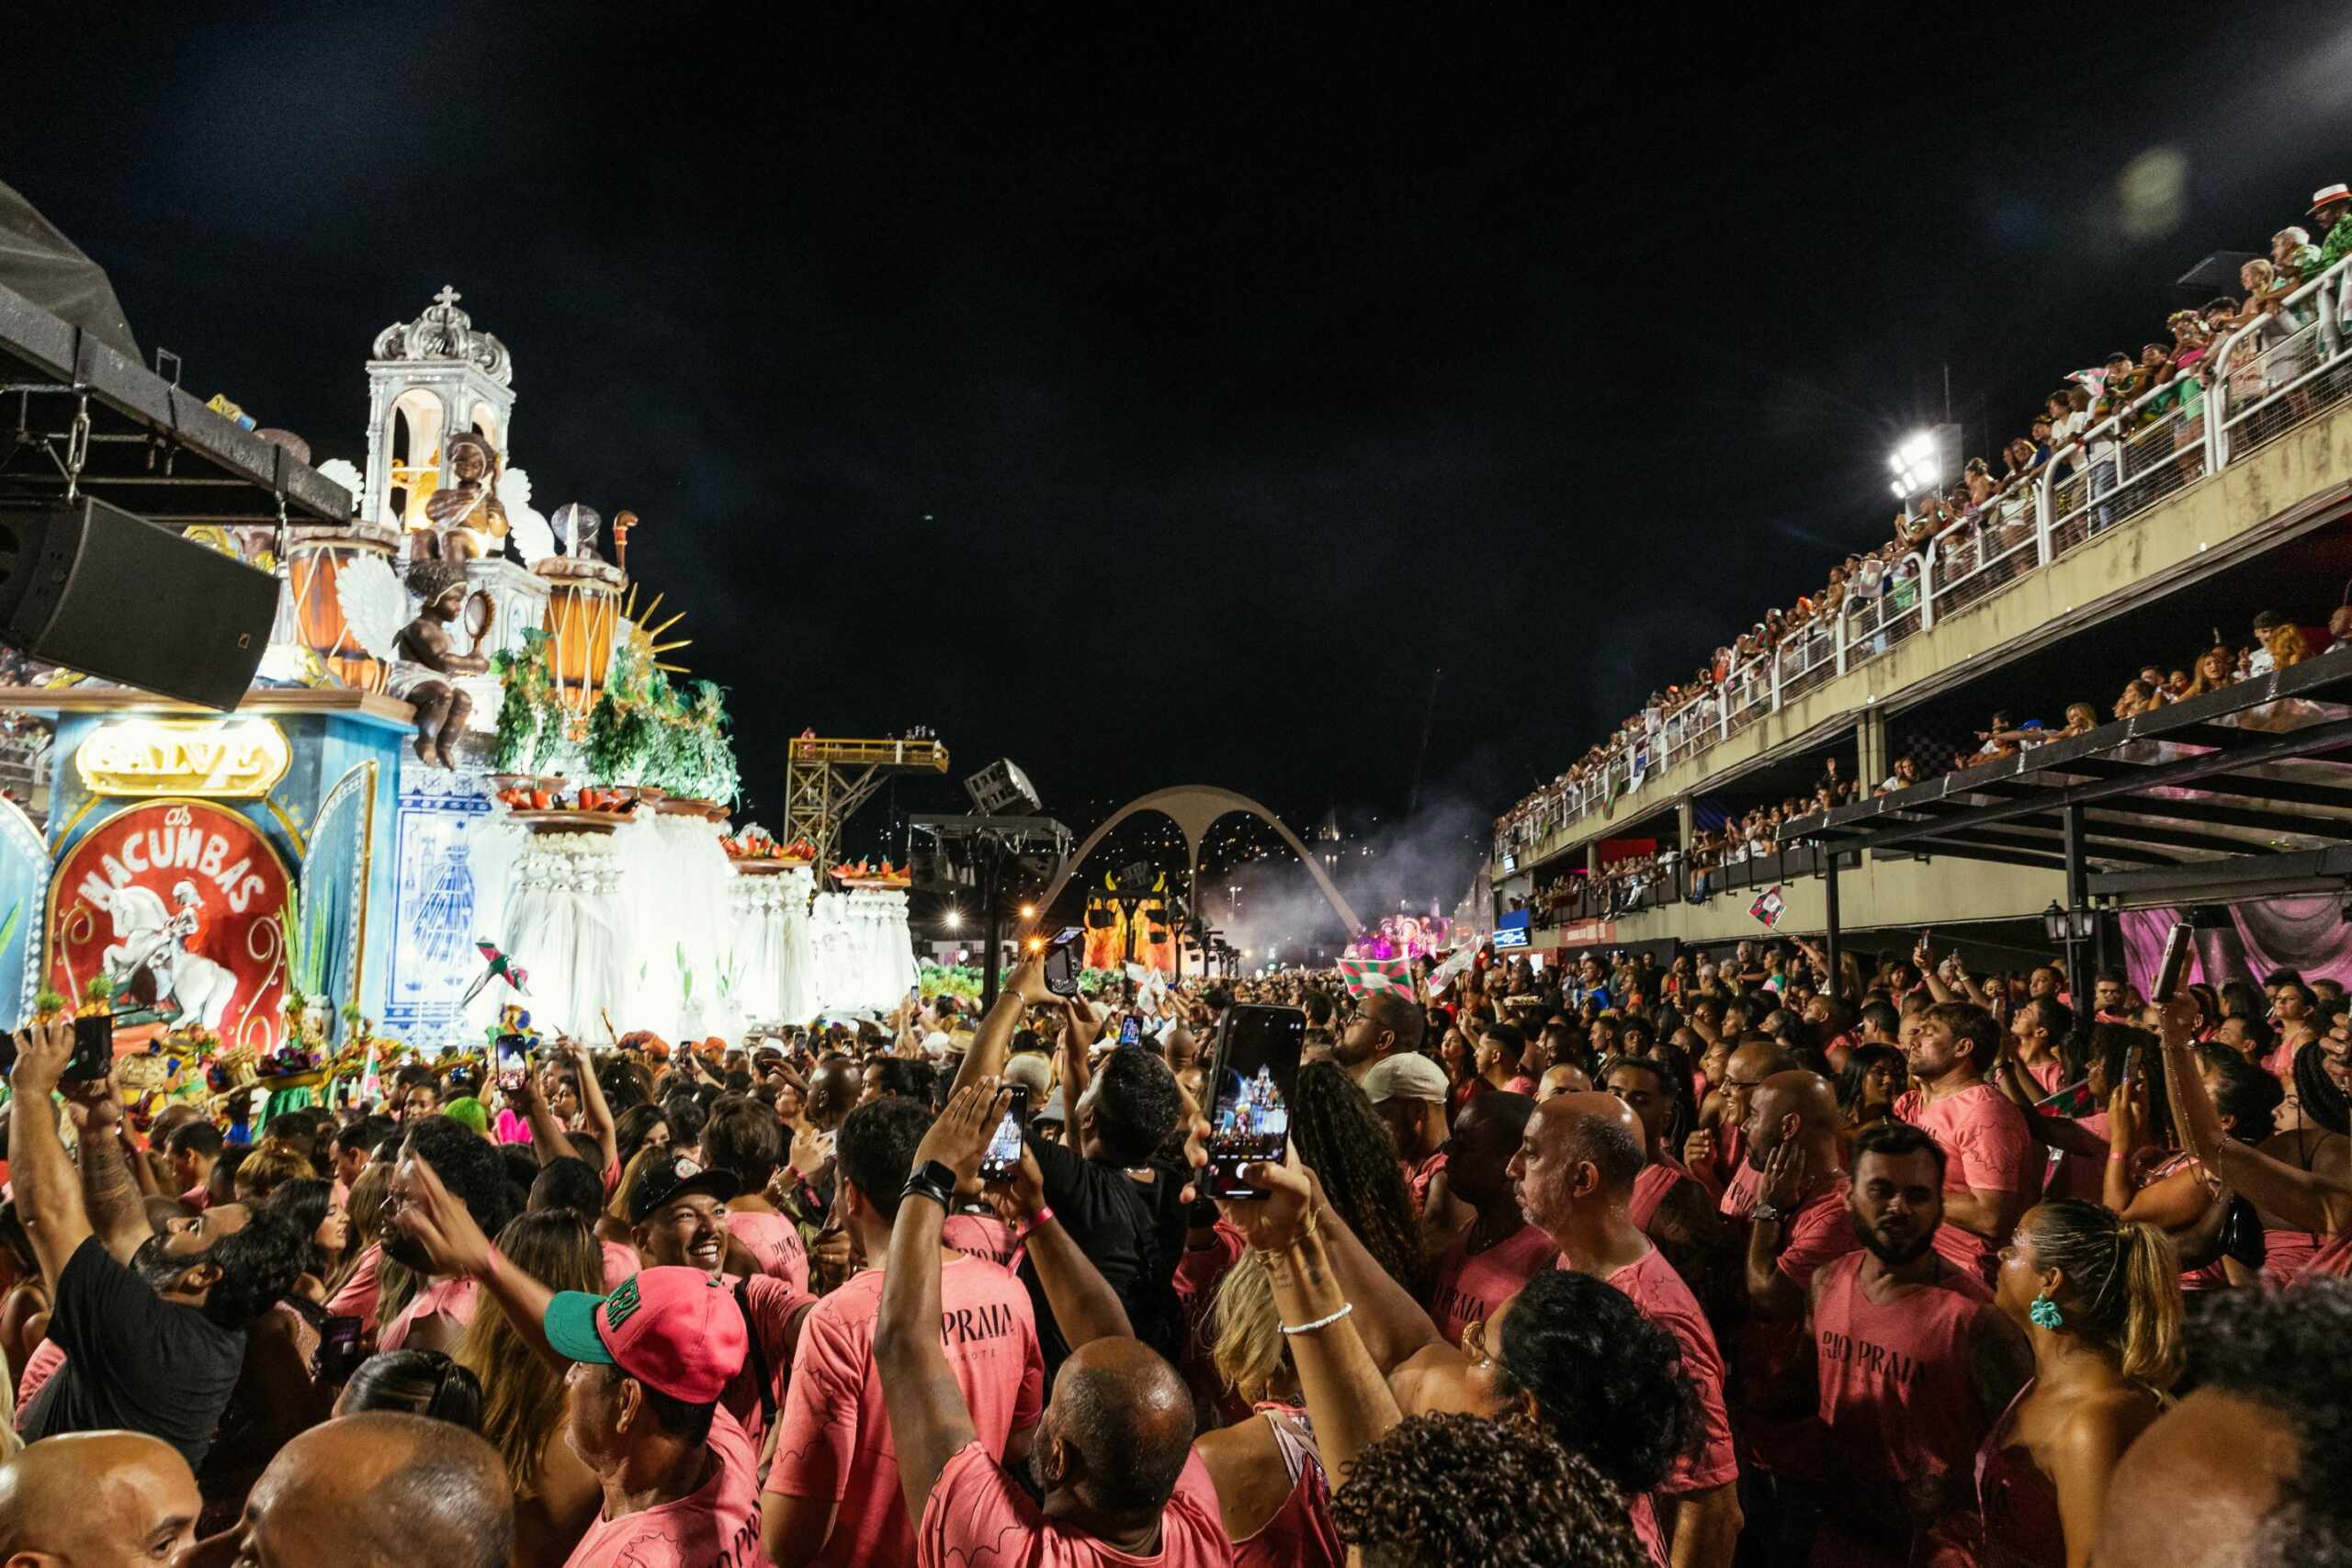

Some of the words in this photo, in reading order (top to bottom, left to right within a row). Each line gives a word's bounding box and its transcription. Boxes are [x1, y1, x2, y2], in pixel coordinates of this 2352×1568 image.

[94, 741, 264, 775] SALVE
[77, 827, 266, 914] MACUMBAS
[940, 1303, 1014, 1347] PRAIA
[1858, 1340, 1926, 1384] PRAIA
